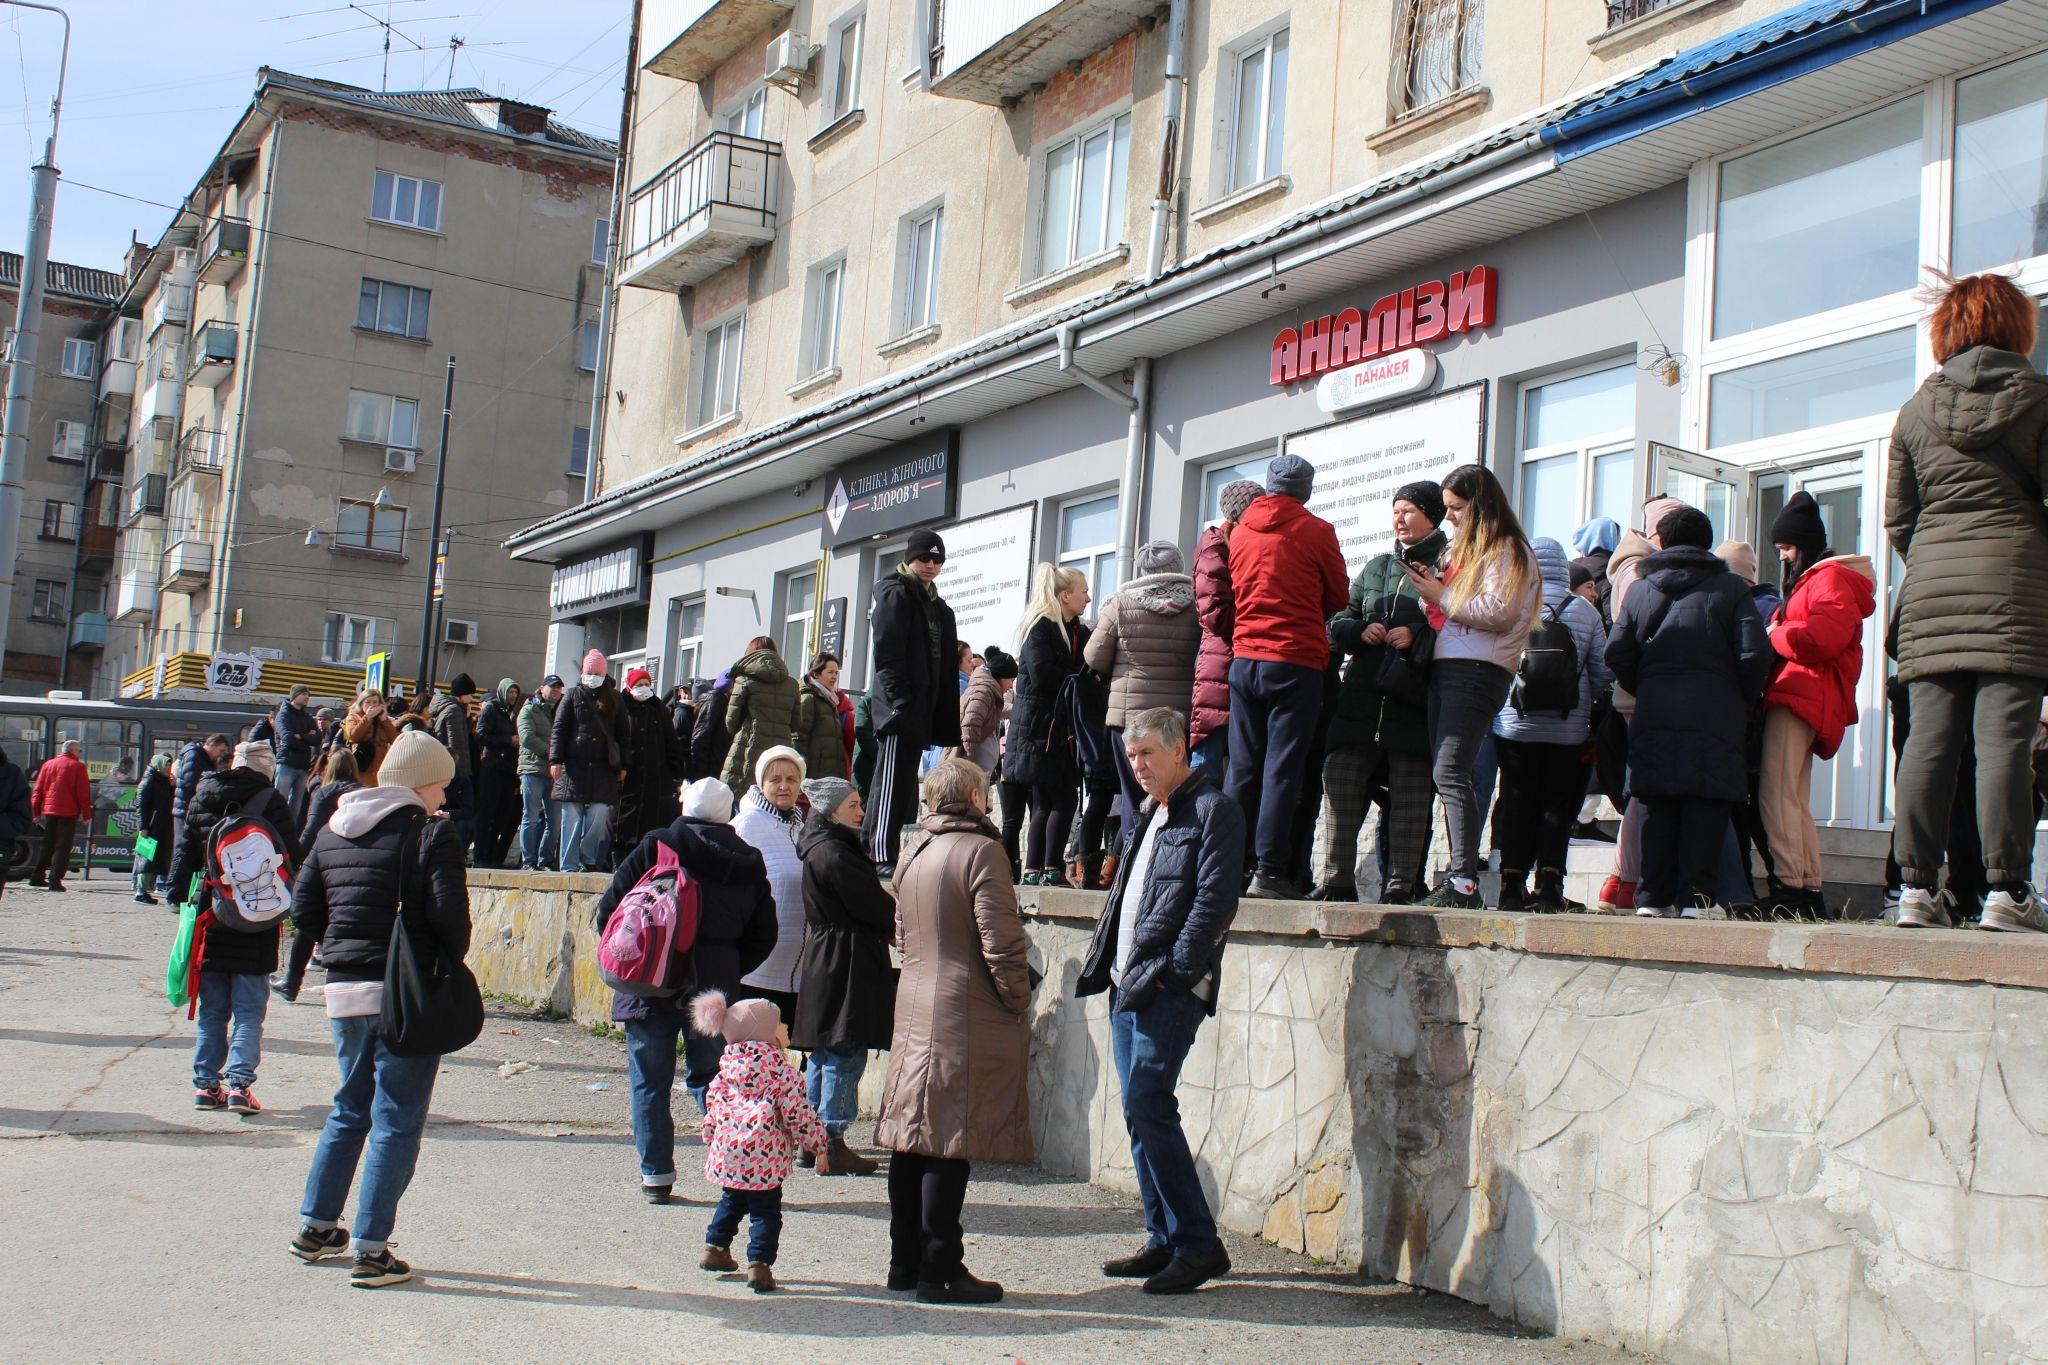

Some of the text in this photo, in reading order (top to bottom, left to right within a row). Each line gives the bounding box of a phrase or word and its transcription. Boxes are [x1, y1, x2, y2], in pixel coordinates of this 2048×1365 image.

[1270, 264, 1492, 386] АНАЛІЗИ
[1354, 359, 1409, 388] ПАНАКЕЯ
[1384, 439, 1425, 457] обстеження
[850, 452, 945, 497] КЛІНІКА ЖІНОЧОГО
[871, 482, 919, 512] ЗДОРОВ'Я
[215, 662, 250, 688] 23
